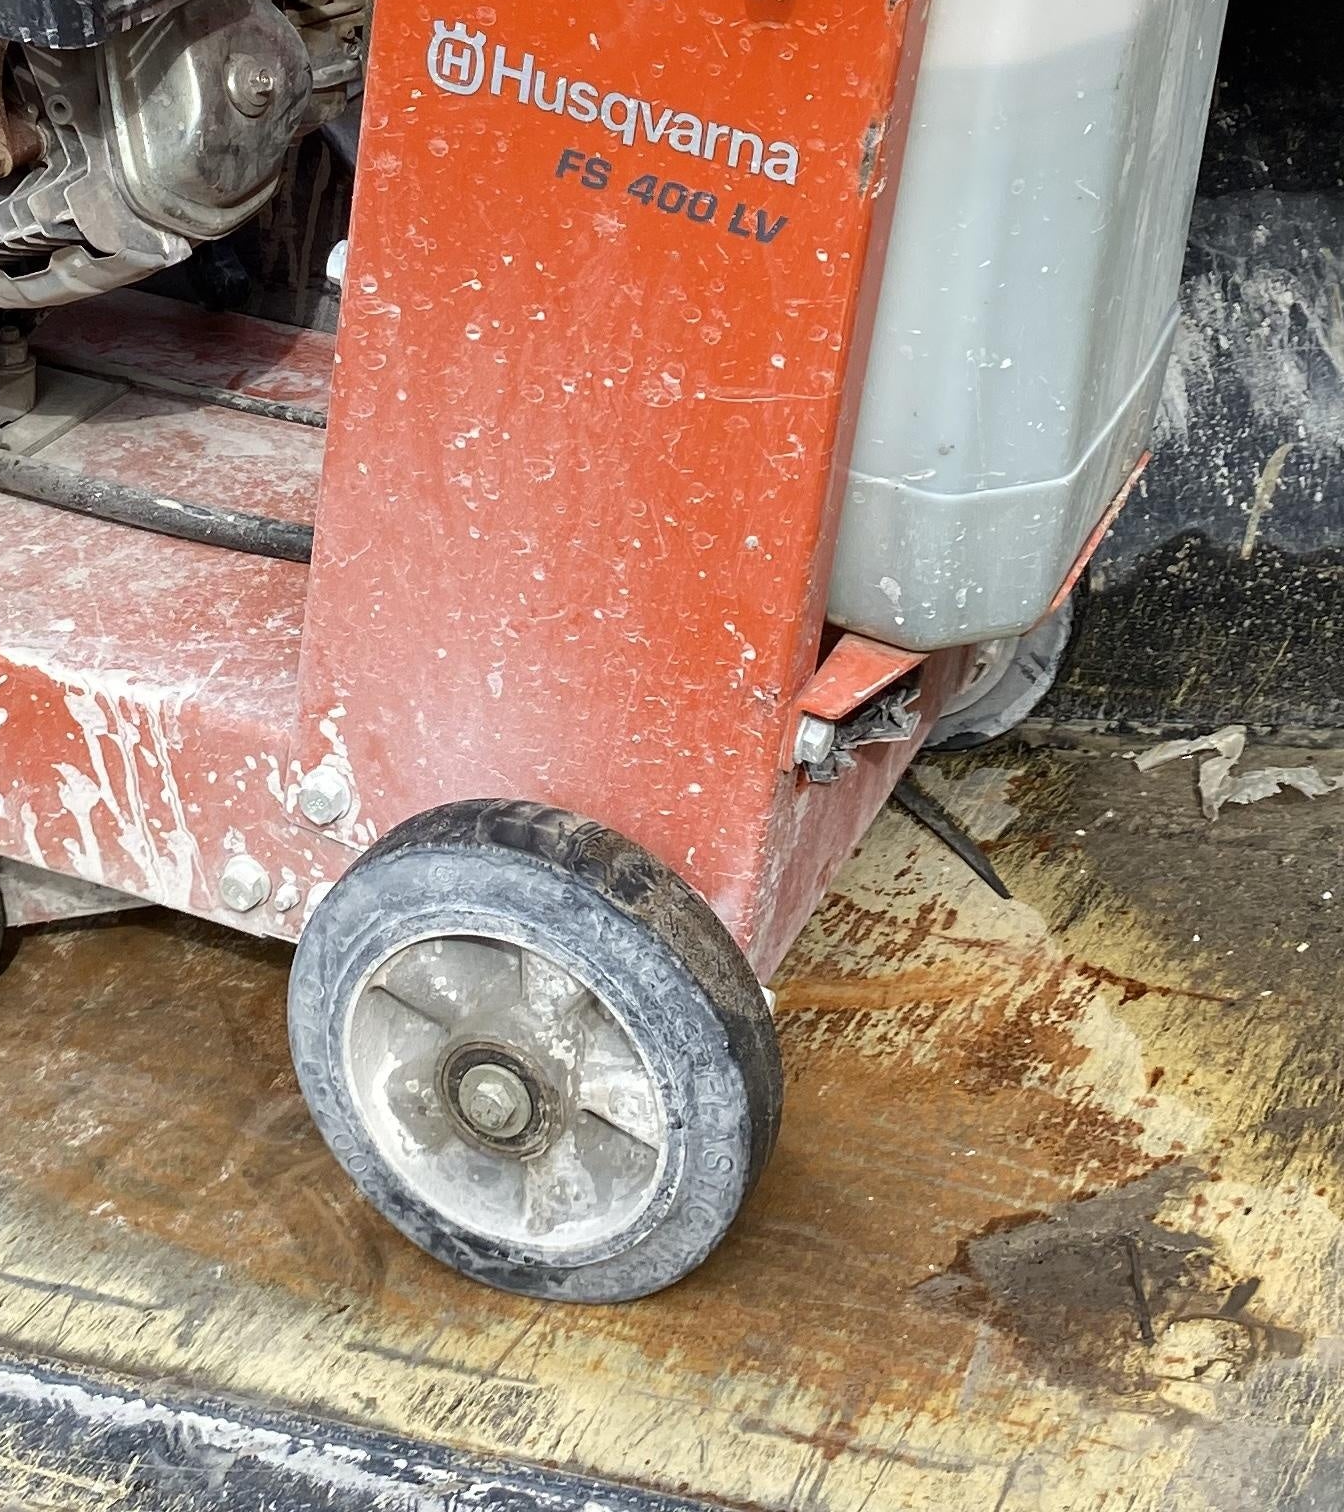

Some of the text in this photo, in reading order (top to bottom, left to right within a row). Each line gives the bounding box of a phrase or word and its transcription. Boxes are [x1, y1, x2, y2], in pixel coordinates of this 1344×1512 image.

[490, 44, 800, 187] Husqvarna
[556, 149, 791, 244] FS 400 LV
